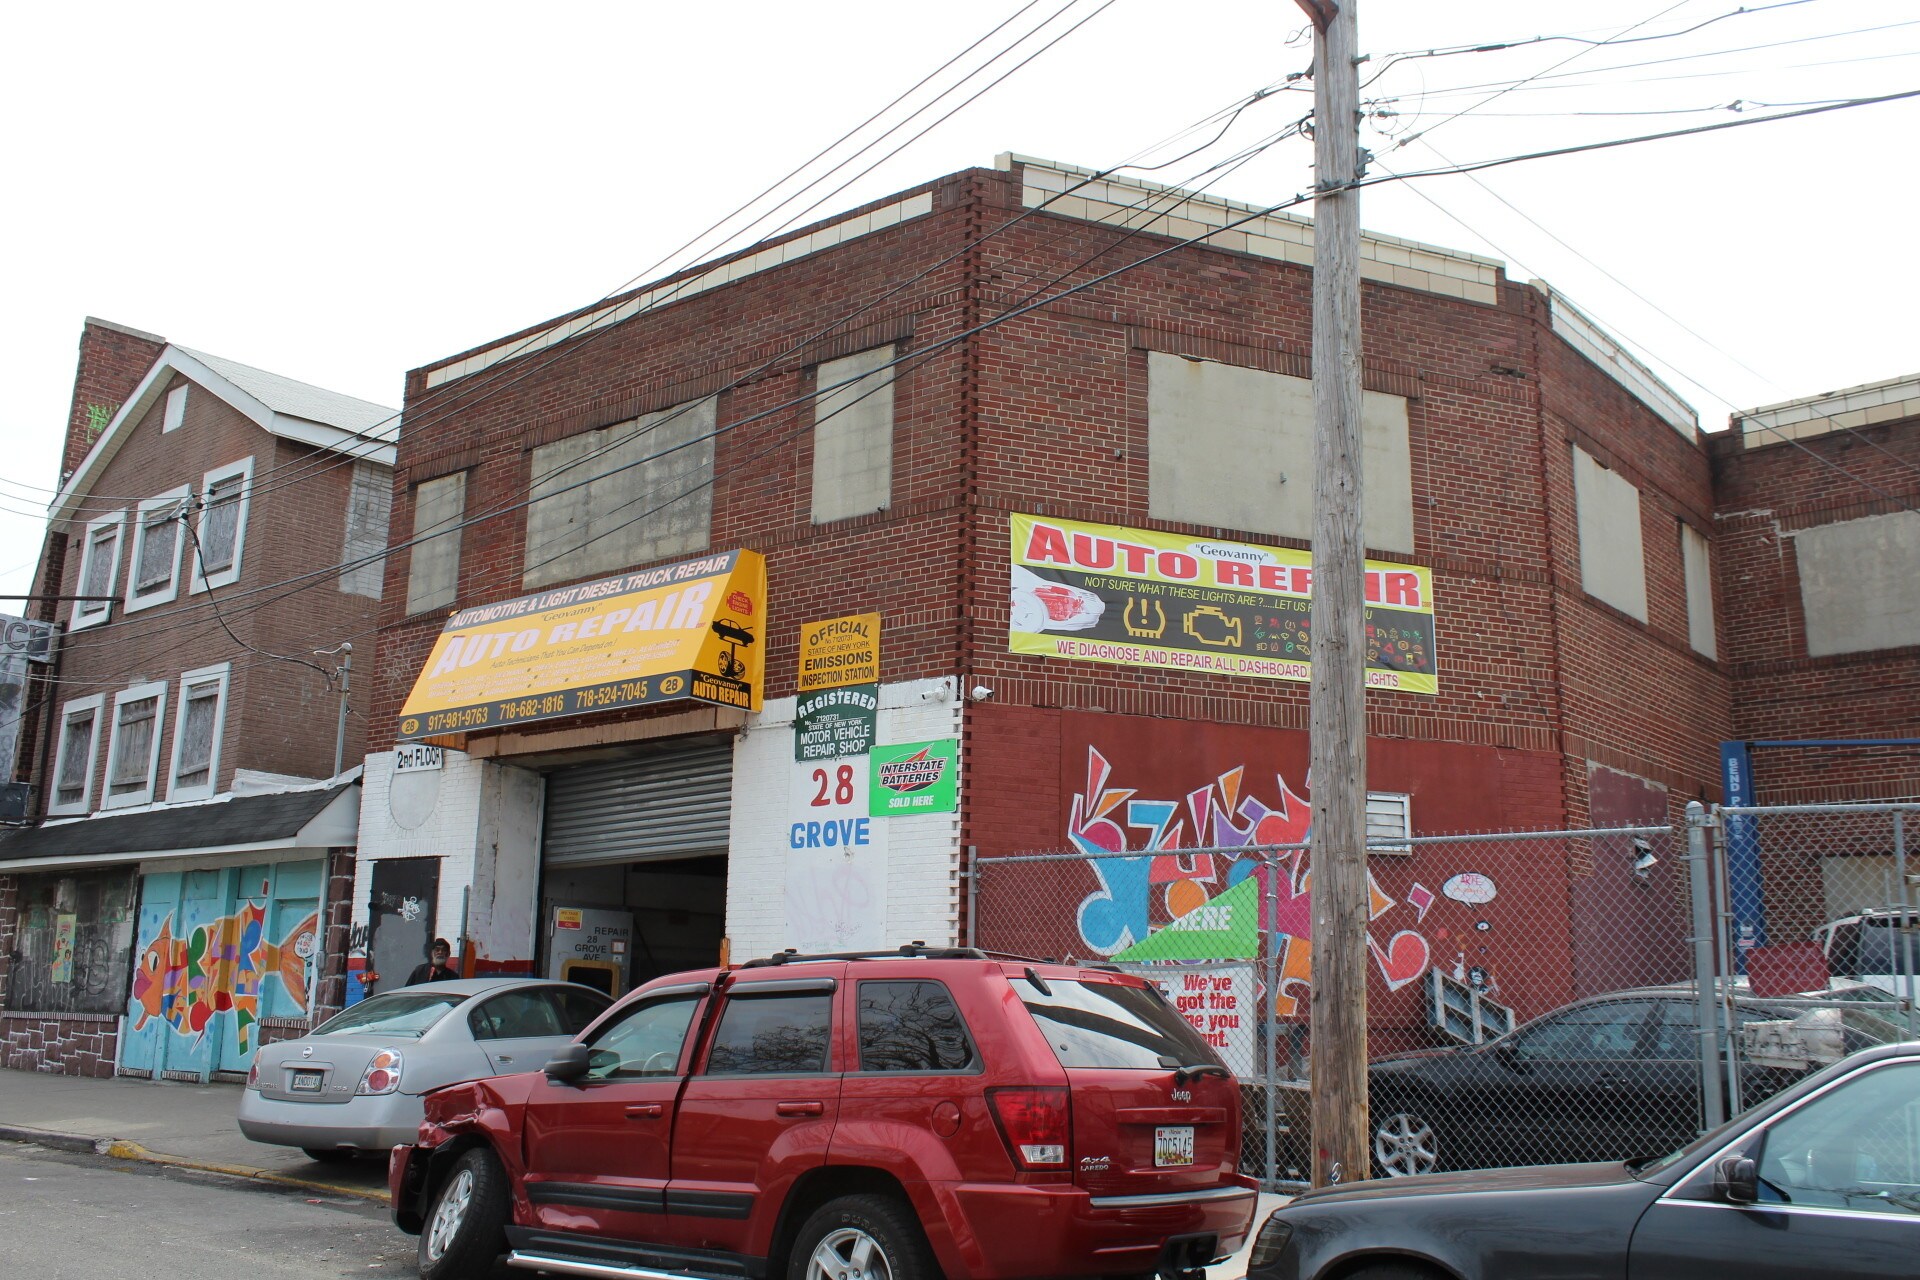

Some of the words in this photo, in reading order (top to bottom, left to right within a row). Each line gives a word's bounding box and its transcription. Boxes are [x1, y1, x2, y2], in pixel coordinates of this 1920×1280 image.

[1025, 523, 1198, 580] AUTO
[1217, 560, 1420, 607] REPIR
[450, 600, 529, 628] AUTOMOTIVE
[527, 598, 538, 610] &
[538, 588, 580, 609] LIGHT
[578, 579, 624, 600] DIESEL
[626, 566, 673, 589] TRUCK
[674, 554, 730, 580] REPAIR
[1085, 576, 1106, 588] NOT
[1108, 579, 1135, 592] SURE
[1137, 583, 1165, 595] WHAT
[1168, 586, 1200, 600] THESE
[1201, 591, 1235, 603] LIGHTS
[1237, 595, 1257, 606] ARE
[1294, 601, 1306, 612] US
[427, 629, 540, 680] AUTO
[546, 581, 714, 645] REPAIR
[809, 621, 869, 646] OFFICIAL
[833, 634, 853, 643] 7120731
[541, 652, 554, 660] That
[555, 648, 567, 657] You
[567, 645, 579, 654] Can
[579, 641, 604, 653] Depend
[808, 647, 826, 655] STATE
[827, 645, 836, 653] OF
[837, 643, 852, 651] NEW
[853, 641, 870, 649] YORK
[805, 651, 872, 671] EMISSIONS
[1057, 640, 1076, 655] WE
[1080, 642, 1140, 661] DIAGNOSE
[1143, 650, 1168, 664] AND
[1171, 652, 1212, 669] REPAIR
[1215, 657, 1236, 671] ALL
[1239, 659, 1307, 678] DASHBOARD
[802, 670, 842, 687] INSPECTION
[845, 665, 875, 681] STATION
[692, 680, 717, 700] AUTO
[719, 686, 749, 707] REPAIR
[405, 719, 415, 732] 28
[428, 707, 488, 731] 917-981-9763
[500, 694, 564, 720] 718-682-1816
[576, 680, 648, 708] 718-524-7045
[665, 678, 678, 692] 28
[798, 691, 876, 718] REGISTERED
[816, 713, 839, 722] 7120731
[800, 730, 831, 745] MOTOR
[834, 725, 870, 740] VEHICLE
[397, 749, 414, 769] 2nd
[415, 747, 440, 767] FLOOR
[803, 743, 835, 758] REPAIR
[839, 739, 866, 753] SHOP
[881, 760, 945, 774] INTERSTATE
[1727, 757, 1740, 792] BEND
[810, 764, 855, 807] 28
[882, 772, 939, 785] BATTERIES
[888, 797, 910, 808] SOLD
[912, 795, 934, 807] HERE
[790, 817, 870, 849] GROVE
[587, 936, 597, 944] 28
[594, 926, 629, 937] REPAIR
[575, 944, 607, 953] GROVE
[583, 953, 600, 961] AVE
[1184, 974, 1232, 991] We've
[1176, 992, 1205, 1013] got
[1209, 992, 1237, 1010] the
[1209, 1015, 1239, 1032] you
[1171, 1088, 1191, 1103] Jeep
[1080, 1155, 1110, 1164] 4x4
[1080, 1164, 1109, 1172] LAREDO
